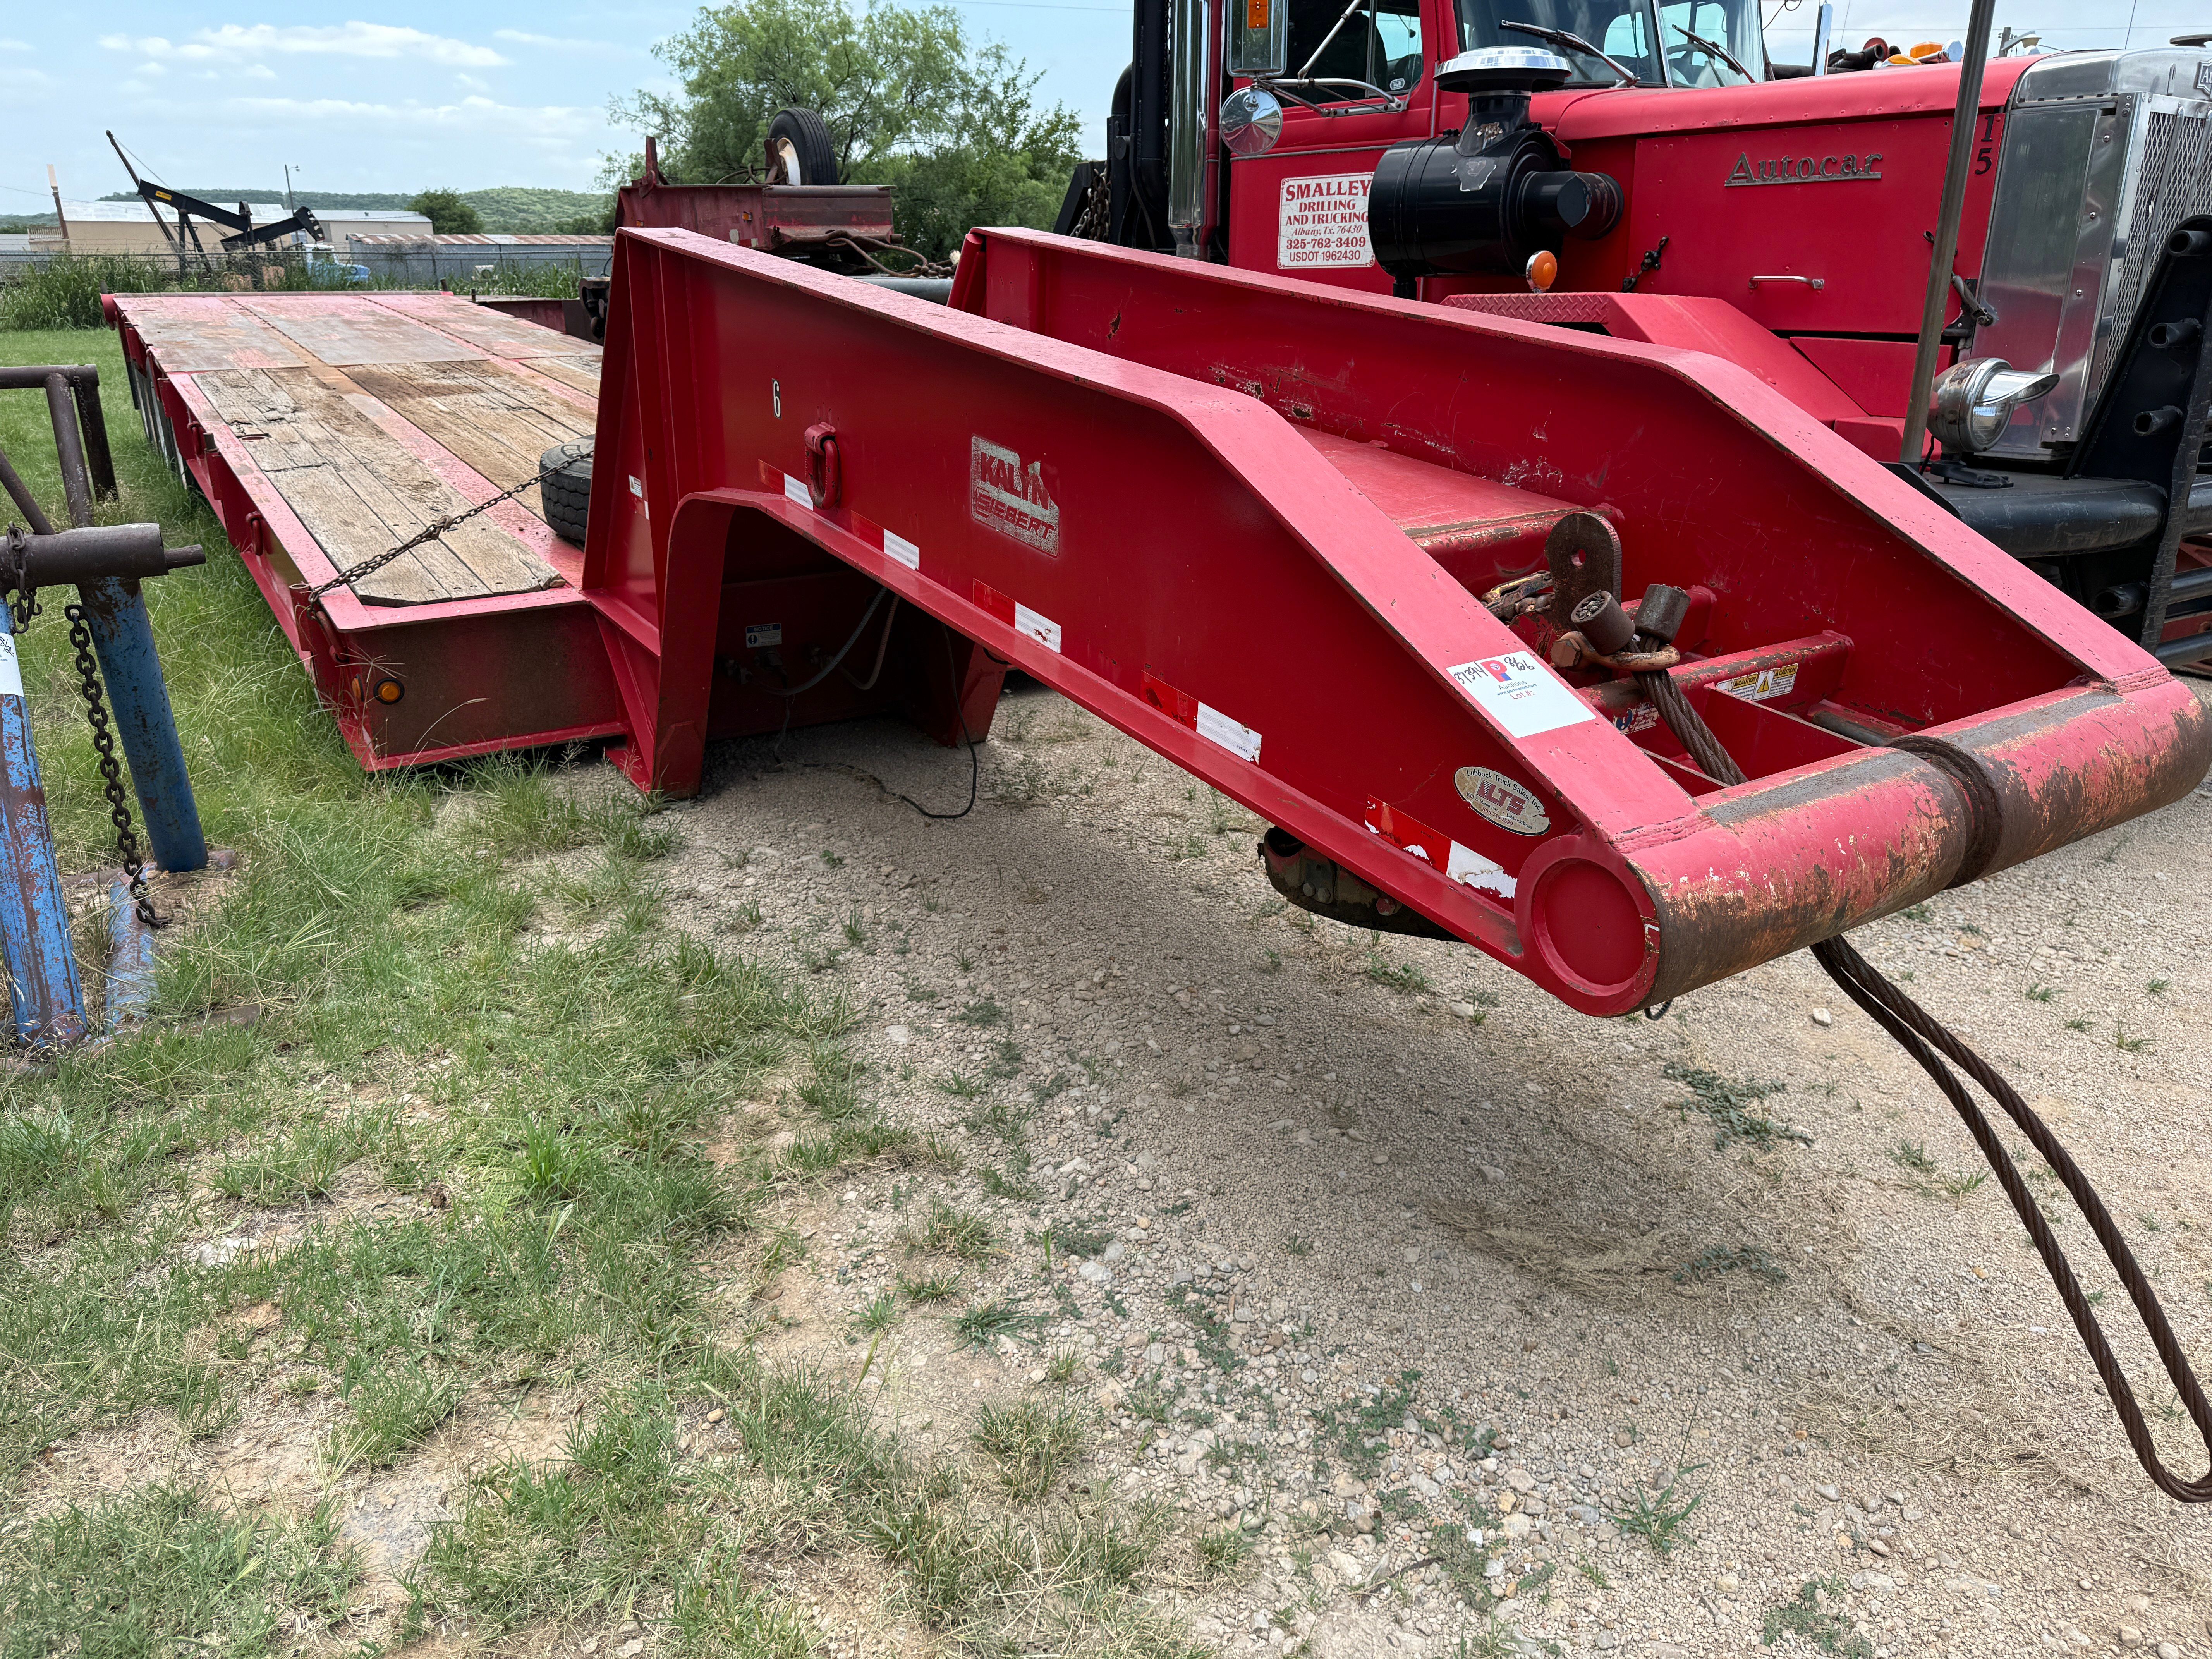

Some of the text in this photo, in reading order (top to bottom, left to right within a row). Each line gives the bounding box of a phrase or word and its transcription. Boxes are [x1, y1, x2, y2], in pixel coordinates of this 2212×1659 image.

[1725, 151, 1883, 184] Autocar
[1285, 179, 1372, 202] SMALLEY
[1299, 199, 1356, 213] DRILLING
[1286, 211, 1369, 225] AND TRUCKING
[1291, 225, 1362, 236] Albany, Tx. 76430
[1286, 237, 1366, 249] 325-762-3409
[1290, 250, 1361, 262] USDOT 1962430
[773, 380, 781, 417] 6
[1779, 667, 1796, 675] CAUTION
[1498, 680, 1527, 690] Auctions
[1738, 677, 1756, 685] CAUTION
[1466, 769, 1542, 812] Lubbock Truck Sales, Inc.
